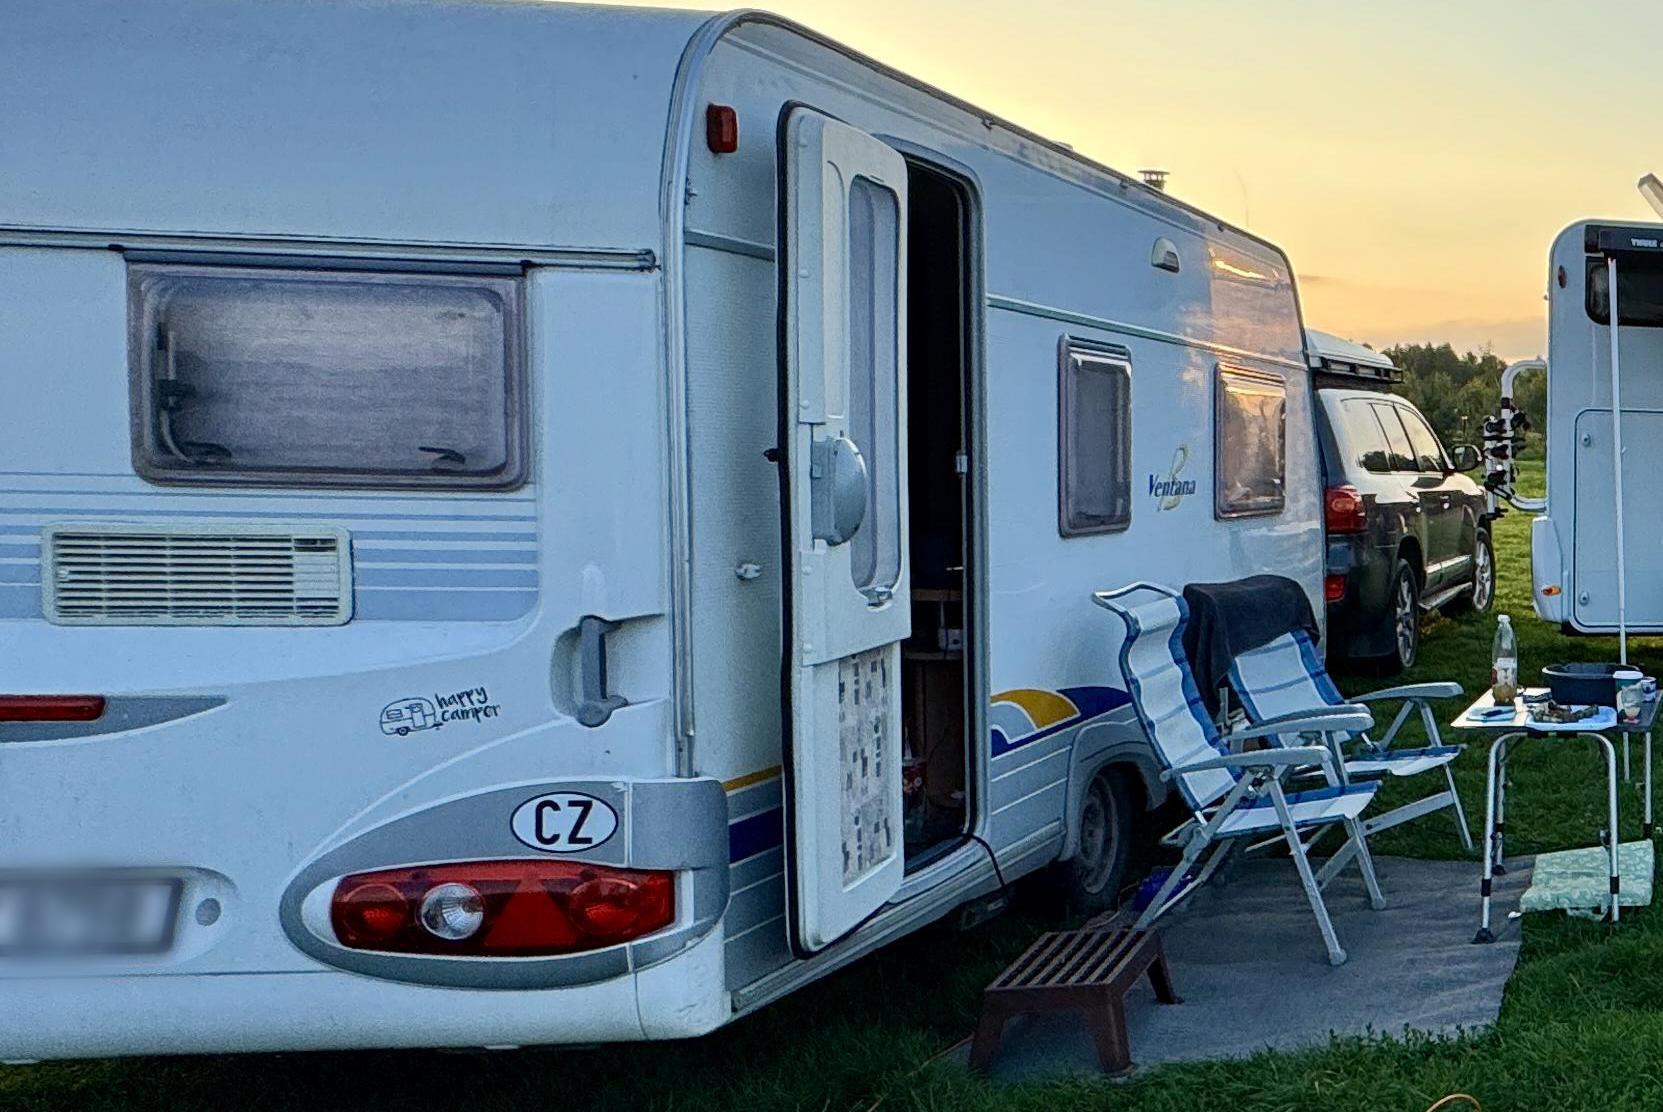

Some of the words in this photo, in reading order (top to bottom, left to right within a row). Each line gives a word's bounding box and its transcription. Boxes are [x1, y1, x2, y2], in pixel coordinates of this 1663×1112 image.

[1149, 474, 1196, 497] Ventana
[434, 686, 488, 709] happy
[441, 704, 501, 723] camper
[535, 800, 593, 845] CZ
